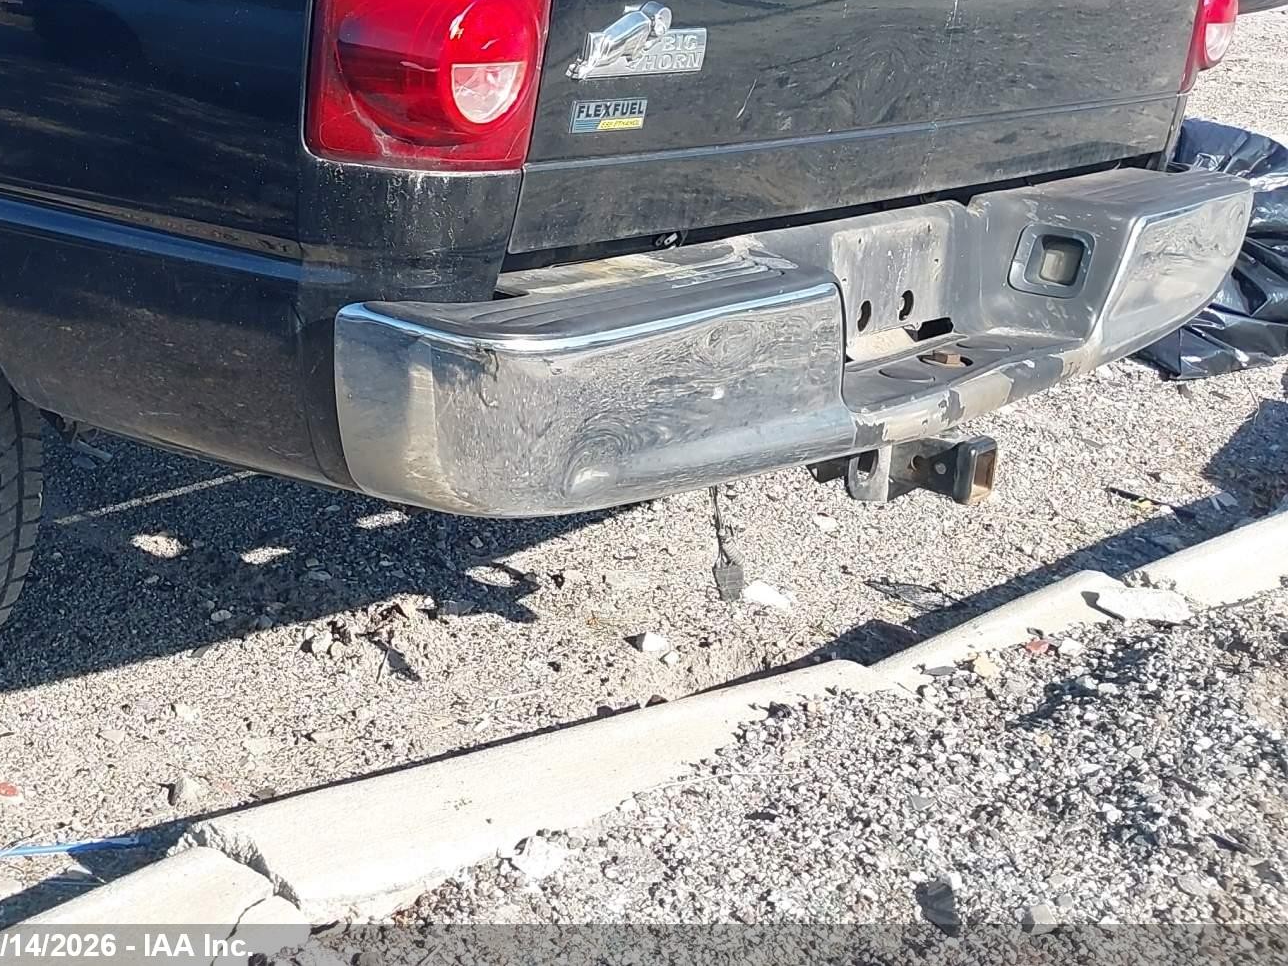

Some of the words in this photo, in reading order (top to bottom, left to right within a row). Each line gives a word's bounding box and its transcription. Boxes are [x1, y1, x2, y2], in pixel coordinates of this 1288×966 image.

[662, 34, 698, 52] BIG
[642, 51, 703, 72] HORN
[577, 101, 644, 119] FLEXFUEL
